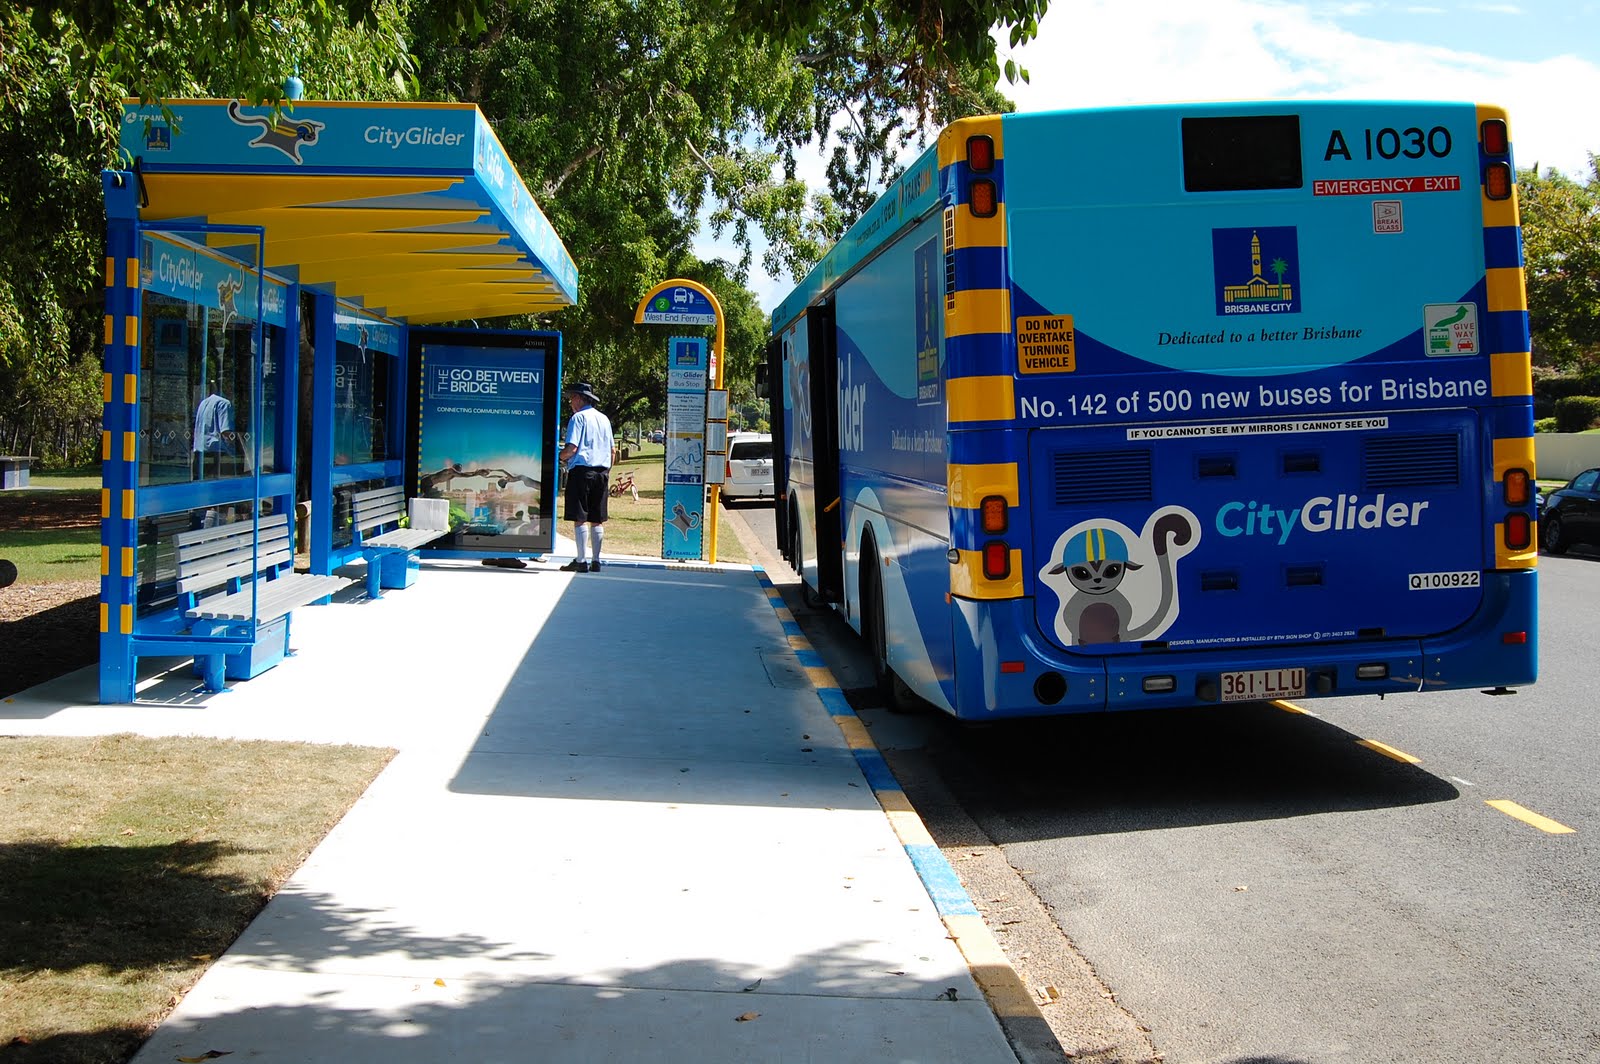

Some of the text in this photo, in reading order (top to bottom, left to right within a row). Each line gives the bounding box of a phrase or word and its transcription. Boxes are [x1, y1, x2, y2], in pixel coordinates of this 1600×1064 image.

[364, 126, 465, 149] CityGlider
[1324, 126, 1452, 160] A 1030
[1314, 178, 1458, 194] EMERGENCY EXIT
[160, 252, 204, 292] CityGlider
[1224, 303, 1292, 314] BRISBANE CITY
[681, 314, 699, 323] Ferry
[1026, 319, 1064, 331] DO NOT
[1019, 331, 1073, 344] OVERTAKE
[1158, 326, 1362, 346] Dedicated to a better Brisbane
[1023, 344, 1070, 356] TURNING
[1026, 357, 1069, 369] VEHICLE
[438, 369, 448, 392] THE
[450, 369, 539, 383] GO BETWEEN
[450, 381, 498, 394] BRIDGE
[1021, 377, 1487, 418] No. 142 of 500 new buses for Brisbane
[1143, 429, 1163, 438] YOU
[1166, 427, 1207, 436] CANNOT
[1210, 426, 1228, 434] SEE
[1231, 425, 1245, 434] MY
[1248, 423, 1293, 432] MIRRORS
[1302, 421, 1342, 430] CANNOT
[1344, 420, 1363, 428] SEE
[1365, 419, 1386, 428] YOU
[1216, 493, 1429, 545] CityGlider
[1410, 572, 1478, 589] Q100922
